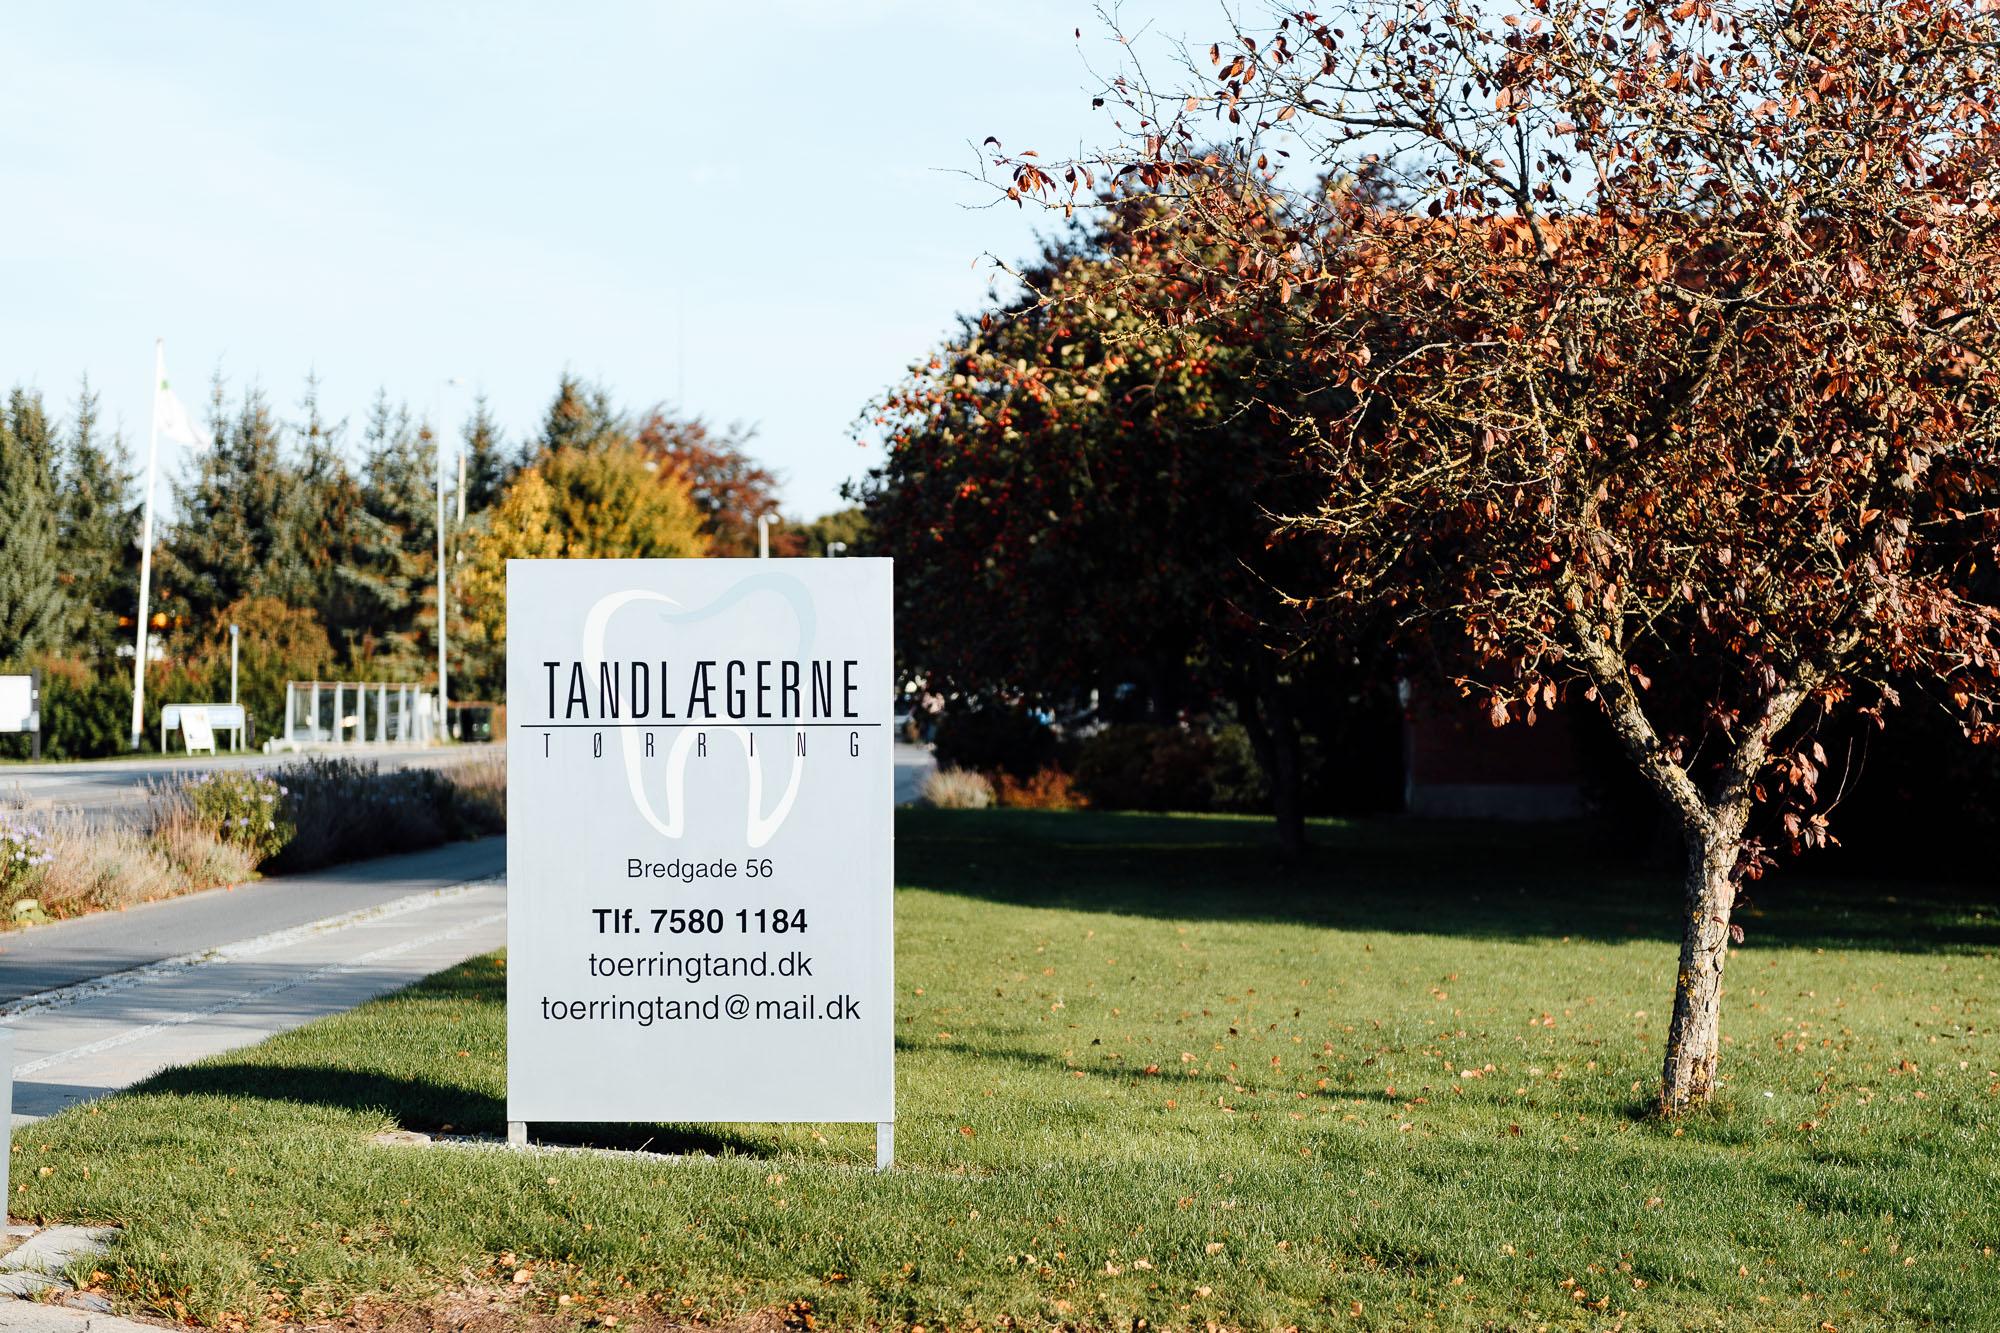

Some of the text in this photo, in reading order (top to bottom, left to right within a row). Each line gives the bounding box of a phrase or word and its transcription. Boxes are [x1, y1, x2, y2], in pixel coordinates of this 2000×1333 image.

[543, 659, 859, 719] TANDLÆGERNE
[543, 731, 860, 759] TØRRING
[627, 858, 773, 884] Bredgade 56
[592, 908, 808, 934] Tlf. 7580 1184
[588, 951, 813, 984] toerringtand.dk
[540, 993, 861, 1027] toerringtand@mail.dk
